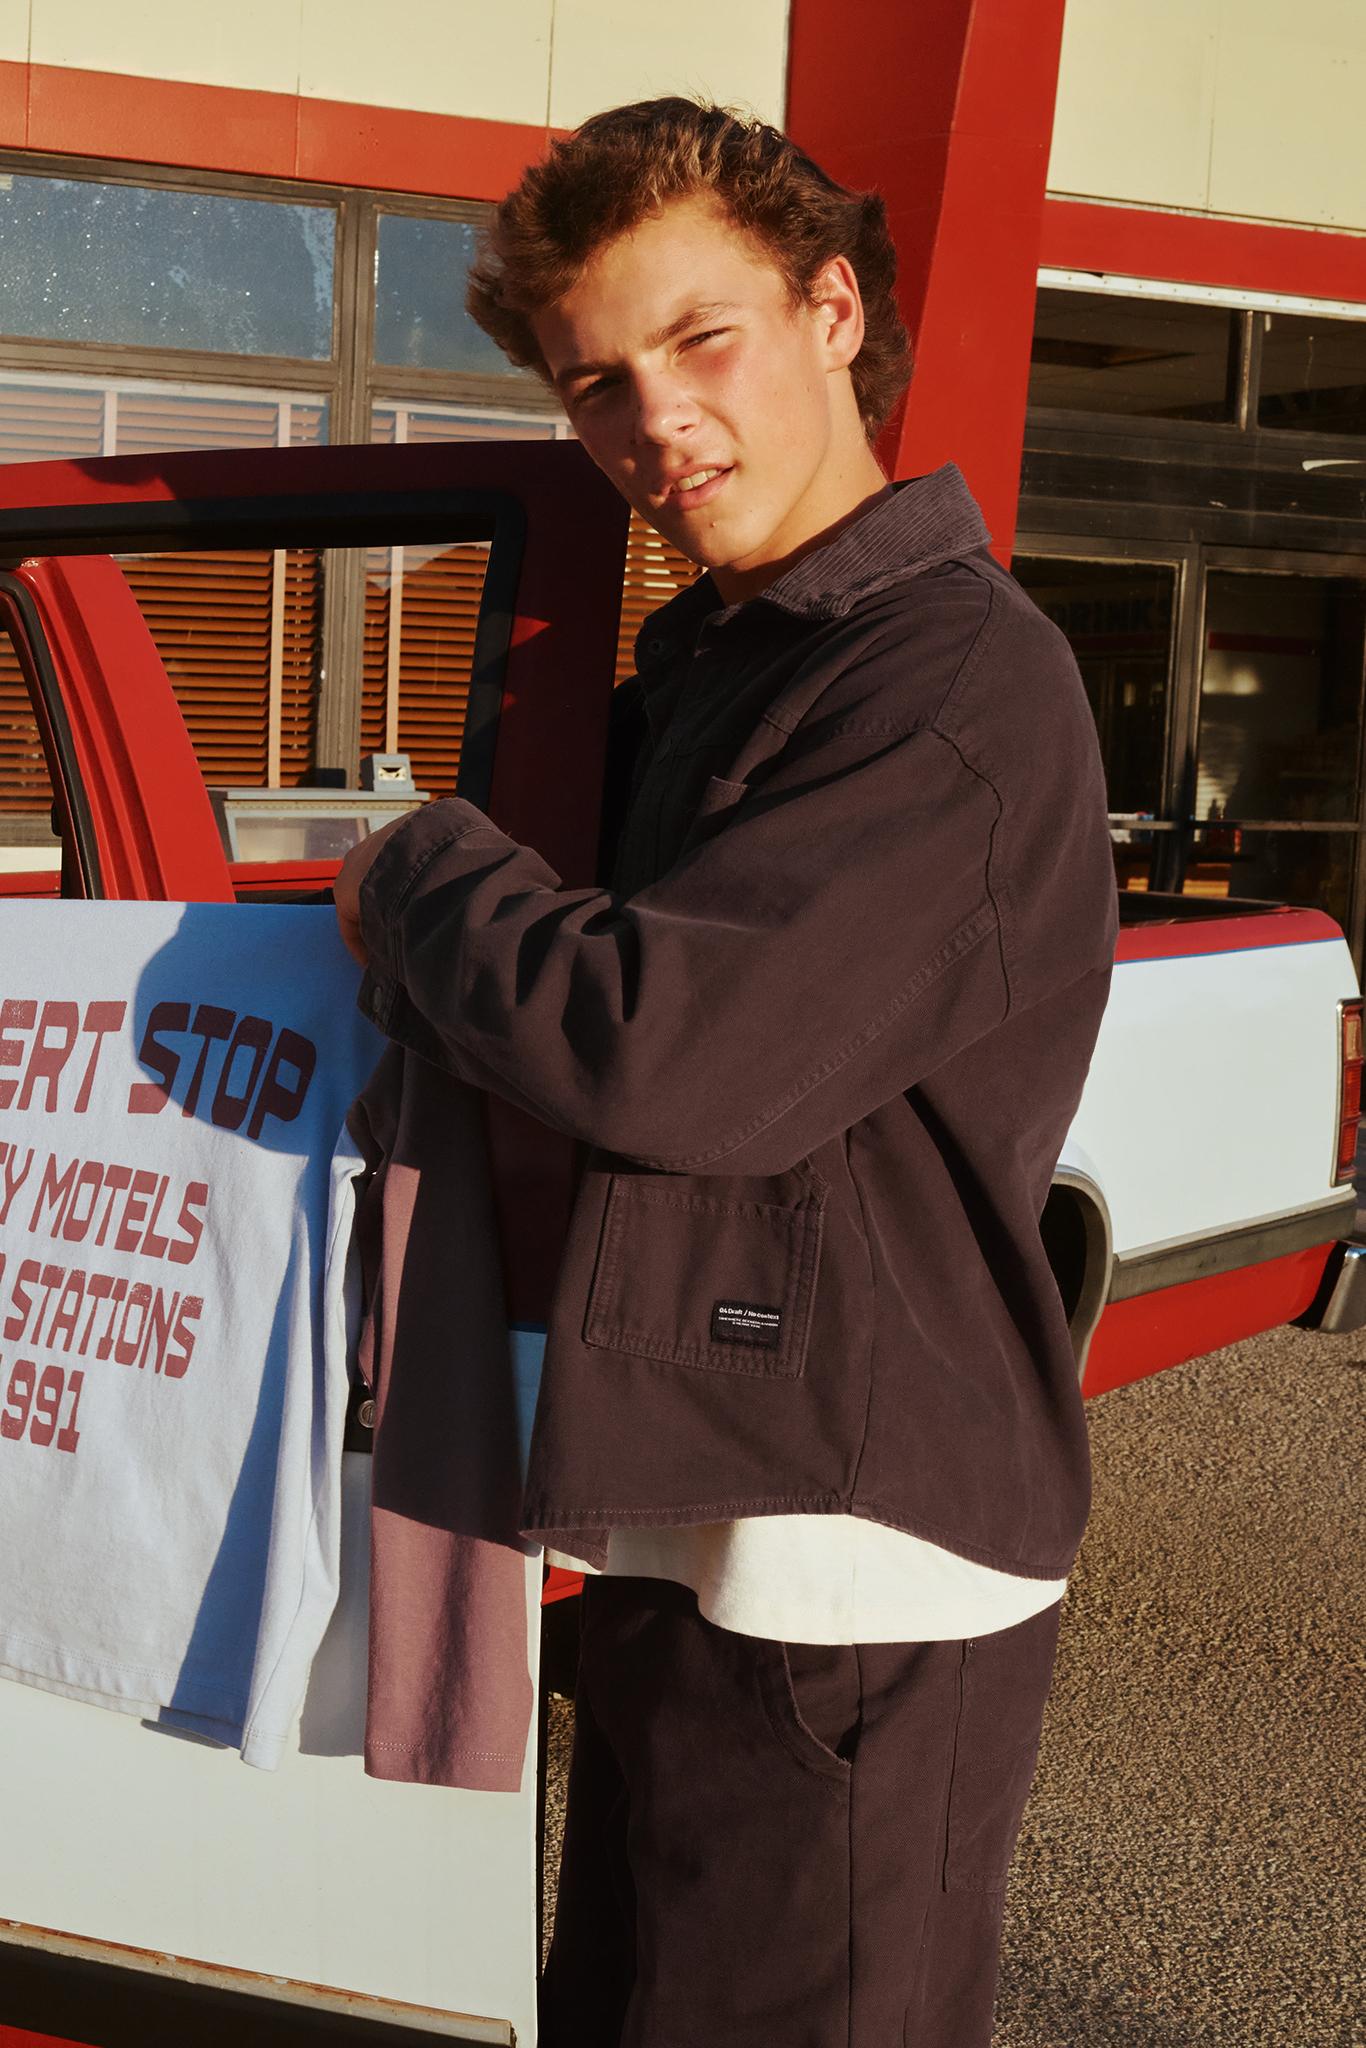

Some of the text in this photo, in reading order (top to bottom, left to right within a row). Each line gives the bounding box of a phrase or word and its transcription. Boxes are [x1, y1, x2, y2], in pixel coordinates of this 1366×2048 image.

[0, 999, 317, 1140] ERT STOP
[0, 1141, 208, 1265] Y MOTELS
[3, 1259, 203, 1379] STATIONS
[0, 1356, 84, 1453] 991
